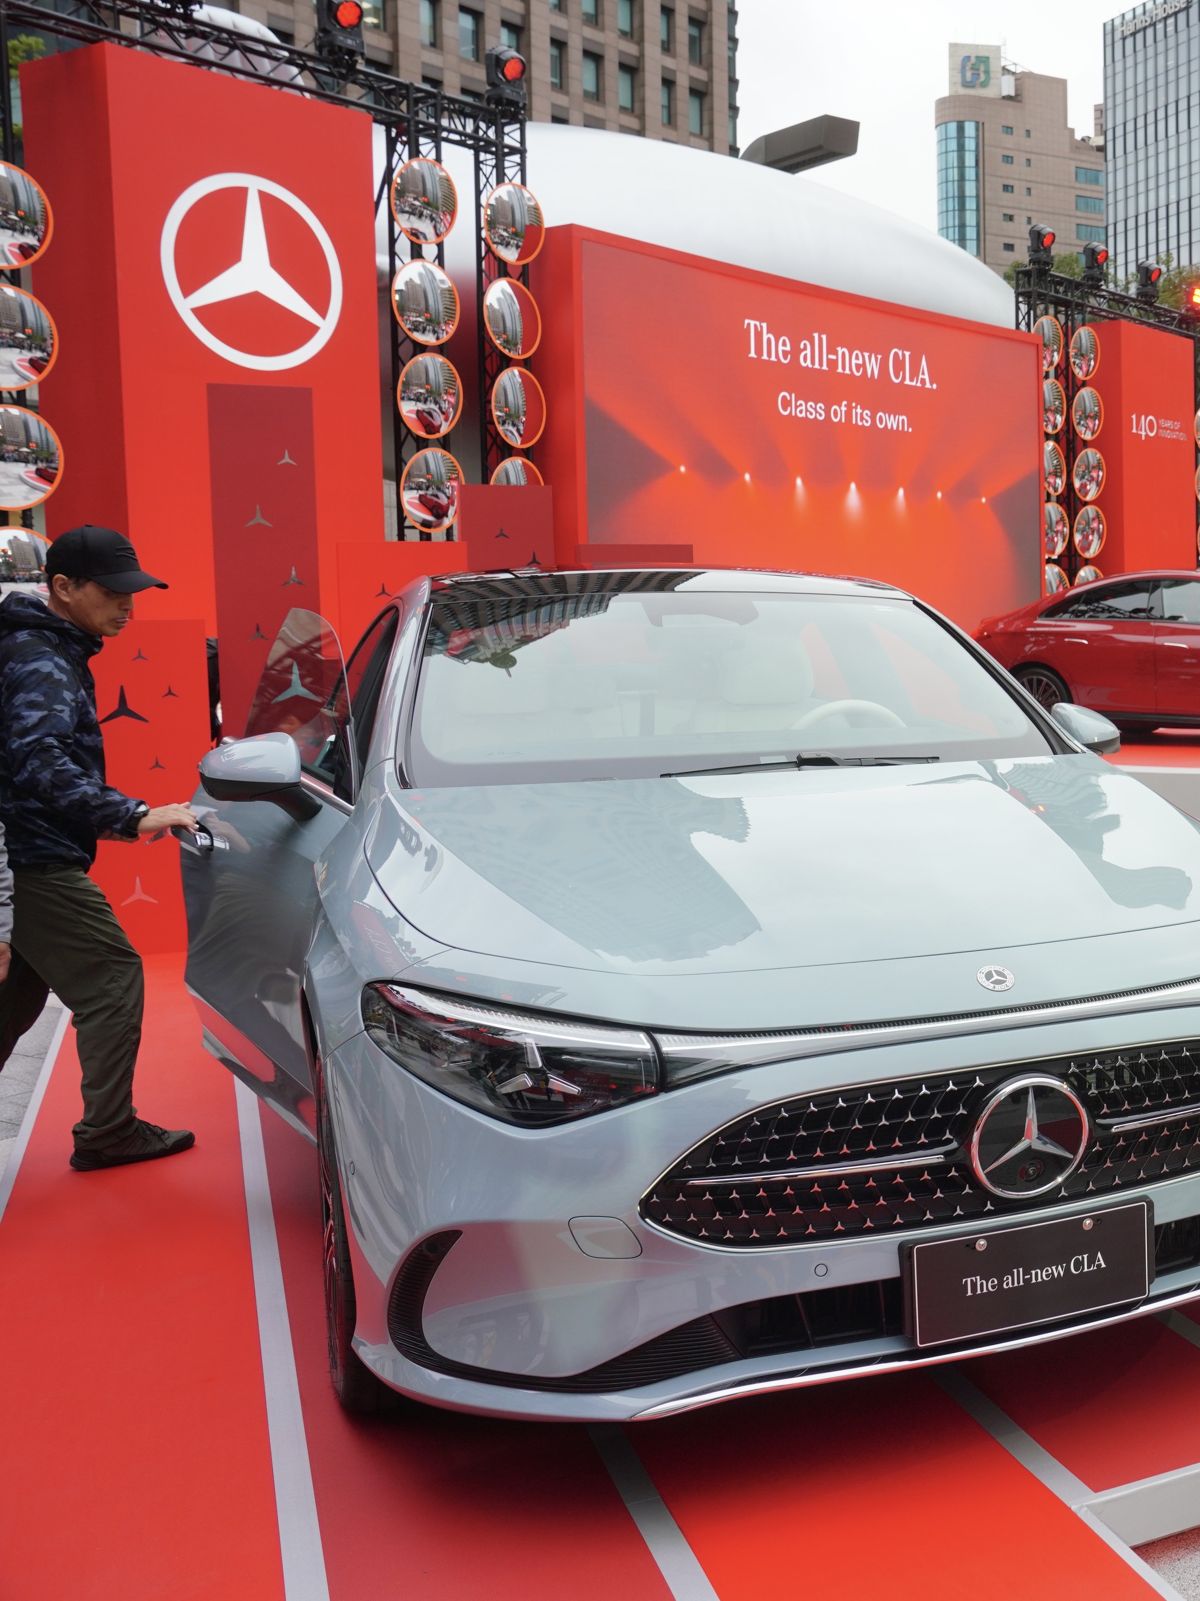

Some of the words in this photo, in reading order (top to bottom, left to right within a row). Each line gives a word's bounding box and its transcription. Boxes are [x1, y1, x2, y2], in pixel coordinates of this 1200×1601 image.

[744, 318, 791, 364] The
[799, 332, 882, 380] all-new
[888, 347, 938, 390] CLA.
[777, 391, 825, 421] Class
[830, 400, 848, 424] of
[852, 402, 871, 427] its
[876, 410, 913, 433] own.
[1131, 412, 1157, 441] 140
[962, 1275, 998, 1297] The
[1003, 1263, 1067, 1290] all-new
[1070, 1250, 1107, 1275] CLA
